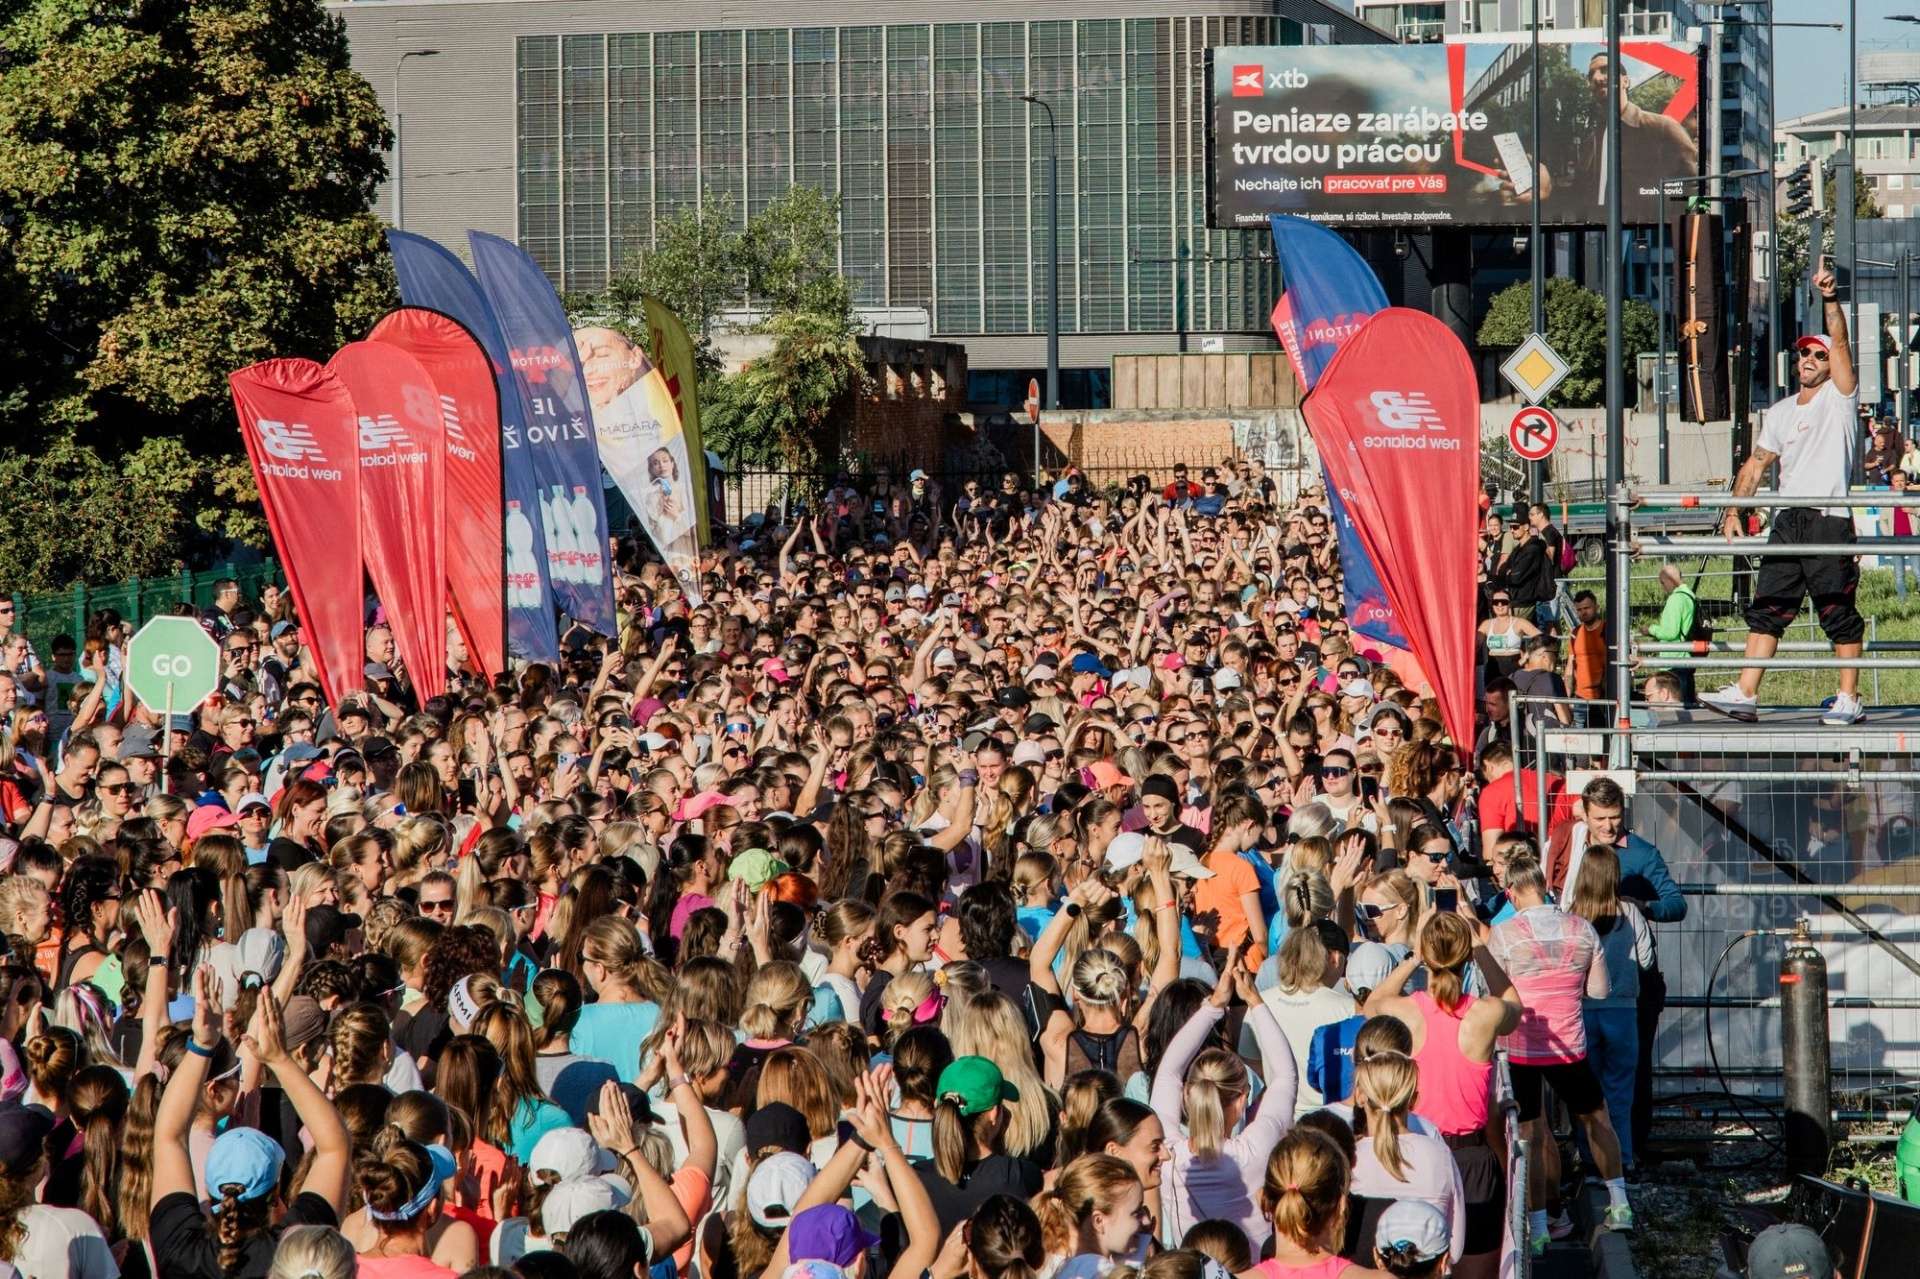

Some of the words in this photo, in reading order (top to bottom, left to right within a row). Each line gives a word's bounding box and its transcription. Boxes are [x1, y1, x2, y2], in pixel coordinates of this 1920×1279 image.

[1269, 68, 1308, 89] xtb
[1233, 107, 1351, 134] Peniaze
[1357, 106, 1488, 133] zarábate
[1232, 139, 1330, 165] tvrdou
[1337, 137, 1442, 169] prácou
[1234, 176, 1298, 193] Nechajte
[1300, 175, 1322, 190] ich
[1328, 175, 1390, 193] pracovať
[1393, 179, 1415, 192] pre
[1418, 176, 1443, 190] Vás
[1235, 213, 1264, 223] Finančné
[1382, 211, 1413, 222] Investujte
[1413, 210, 1453, 221] zodpovedne.
[152, 654, 192, 677] GO
